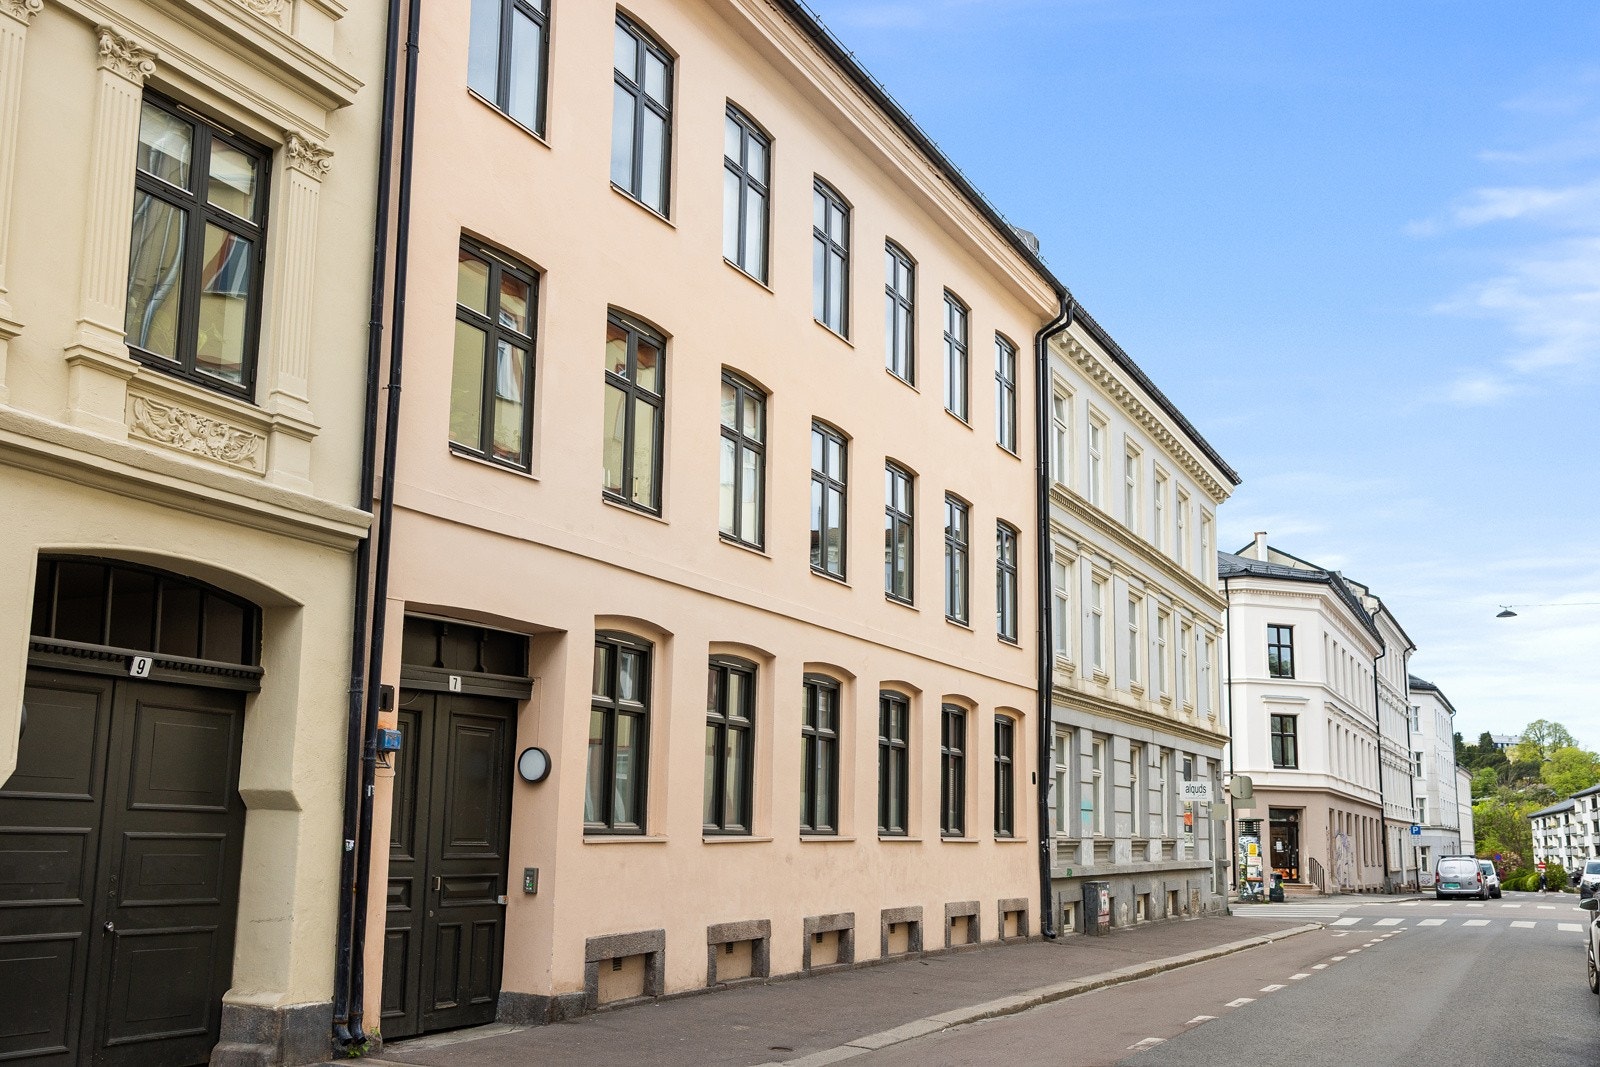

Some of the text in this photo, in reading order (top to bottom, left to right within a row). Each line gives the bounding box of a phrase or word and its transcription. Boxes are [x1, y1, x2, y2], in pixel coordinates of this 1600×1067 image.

[136, 658, 146, 675] 9
[453, 677, 458, 690] 7
[1185, 783, 1207, 796] alquds
[1412, 826, 1419, 834] P
